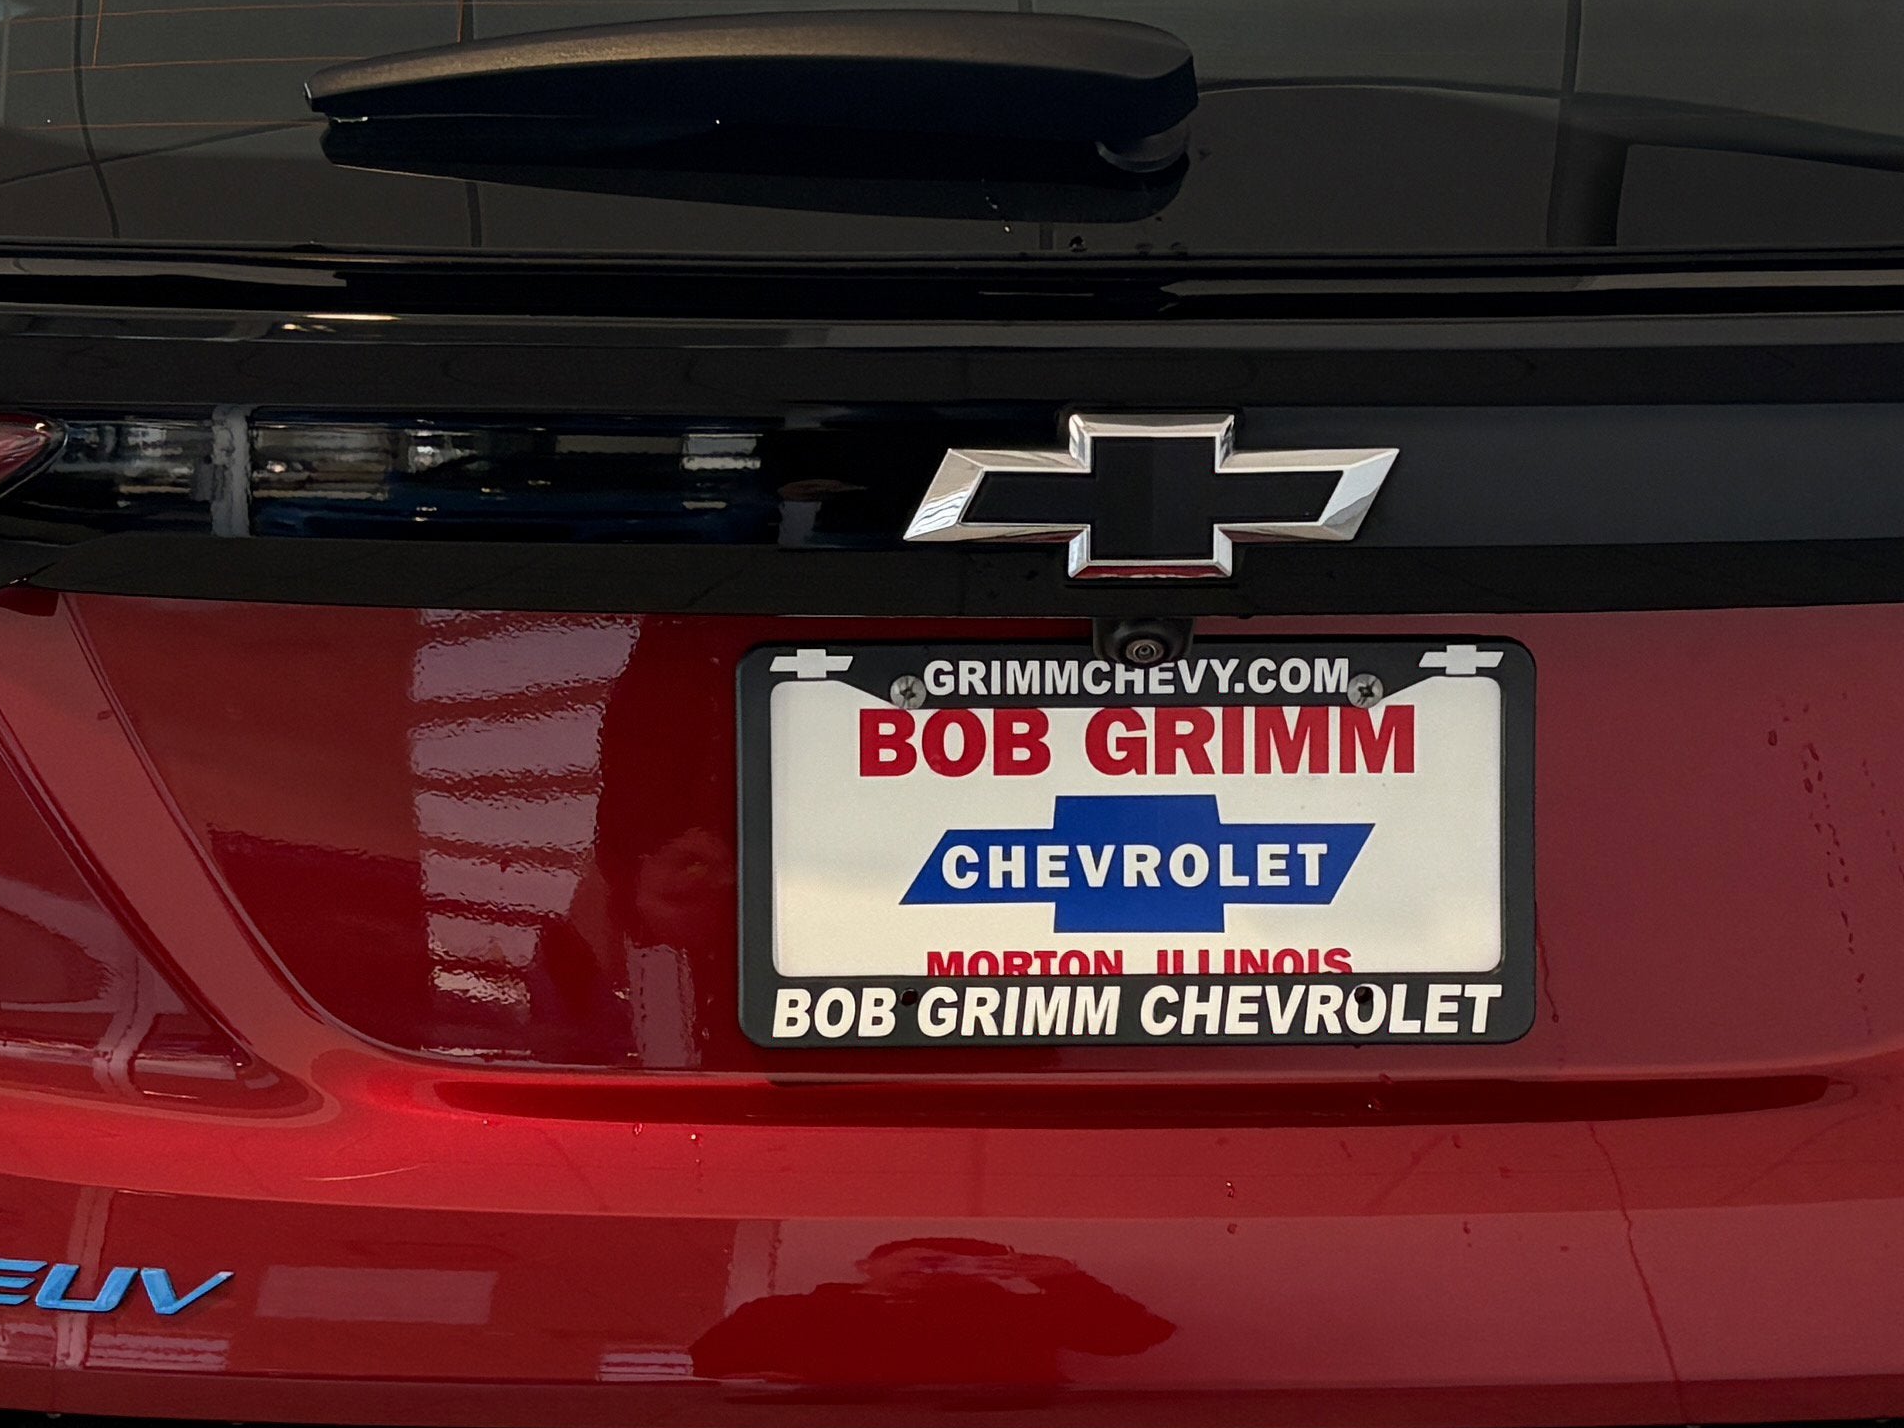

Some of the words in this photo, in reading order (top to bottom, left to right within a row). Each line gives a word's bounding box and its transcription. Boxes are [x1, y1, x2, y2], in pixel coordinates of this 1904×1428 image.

[922, 657, 1349, 696] GRIMMCHEVY.COM
[860, 706, 1053, 779] BOB
[1084, 703, 1417, 778] GRIMM
[941, 842, 1329, 890] CHEVROLET
[771, 986, 898, 1039] BOB
[915, 984, 1122, 1038] GRIMM
[1139, 982, 1504, 1036] CHEVROLET
